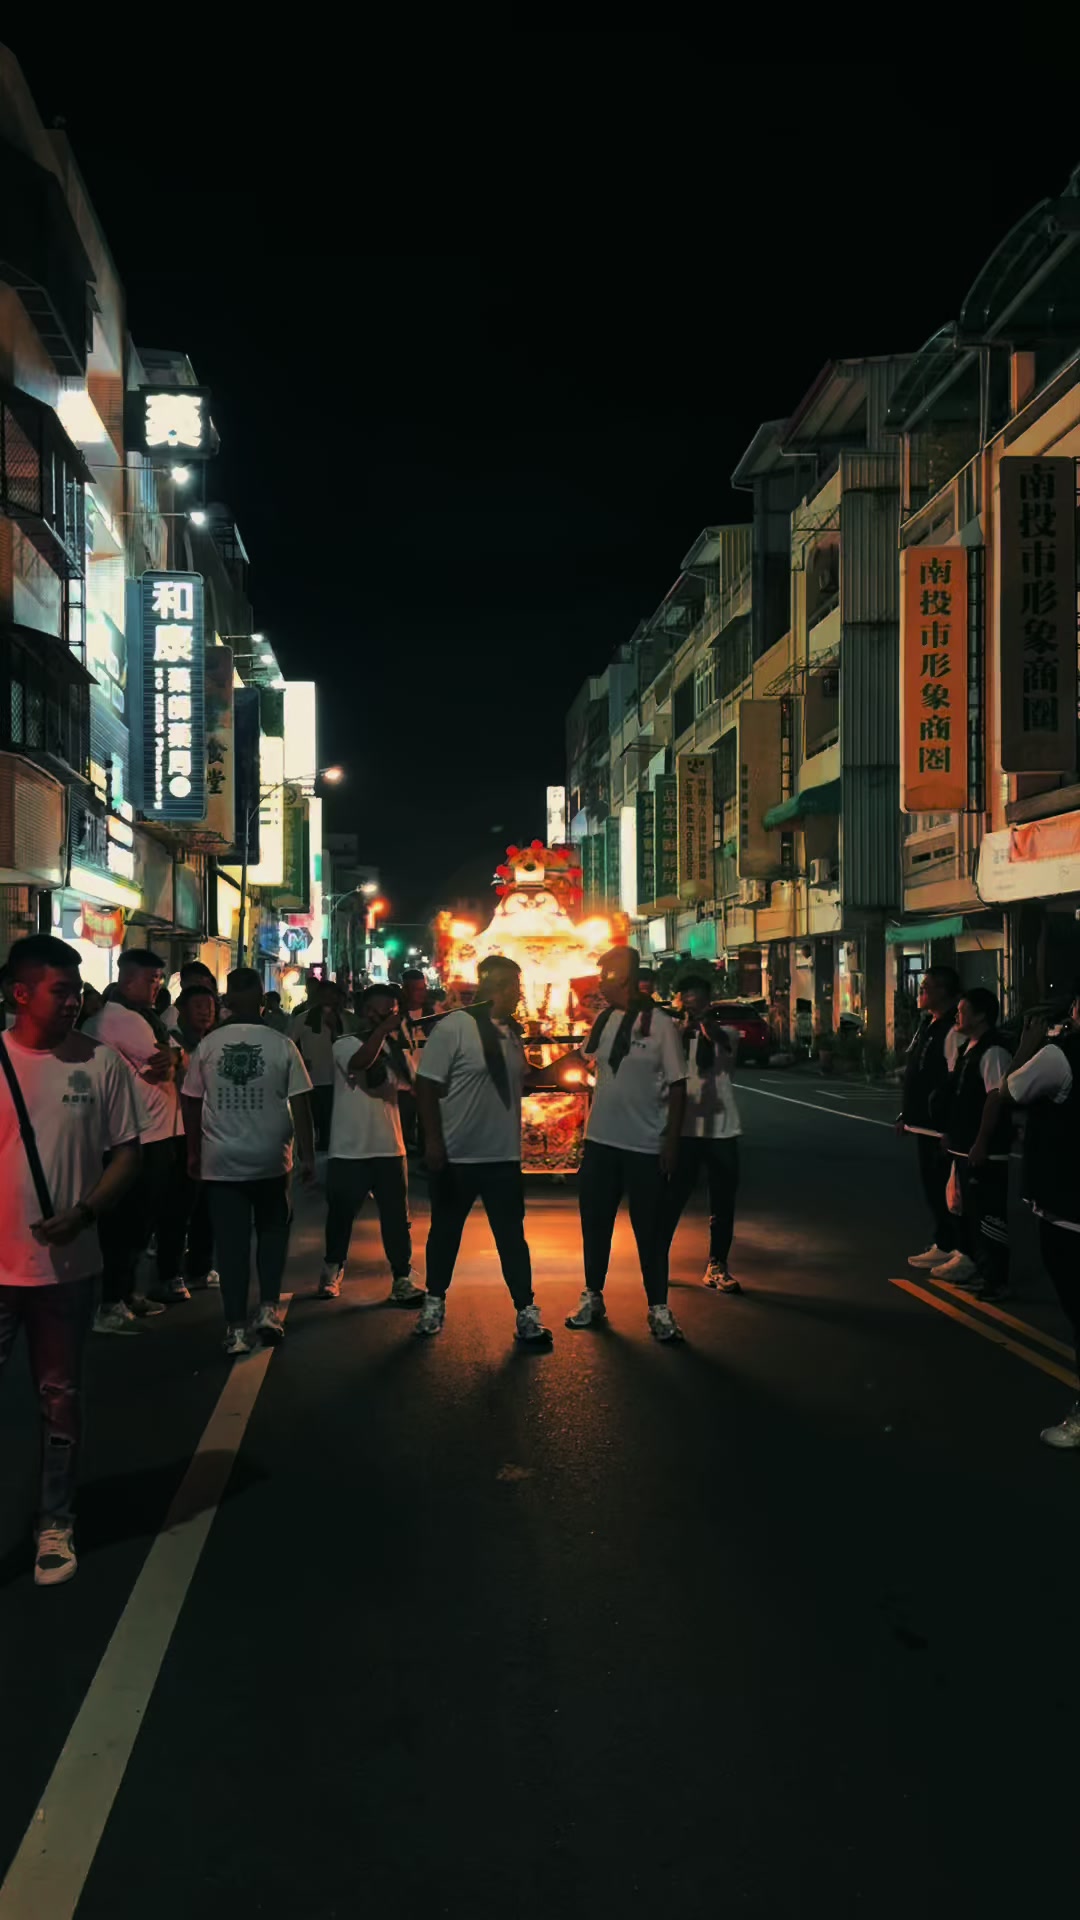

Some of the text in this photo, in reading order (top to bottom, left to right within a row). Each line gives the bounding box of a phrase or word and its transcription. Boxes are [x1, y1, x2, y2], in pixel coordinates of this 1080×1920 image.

[919, 557, 952, 773] 南投市形象商圈
[1018, 463, 1059, 731] 南投市形象商圈
